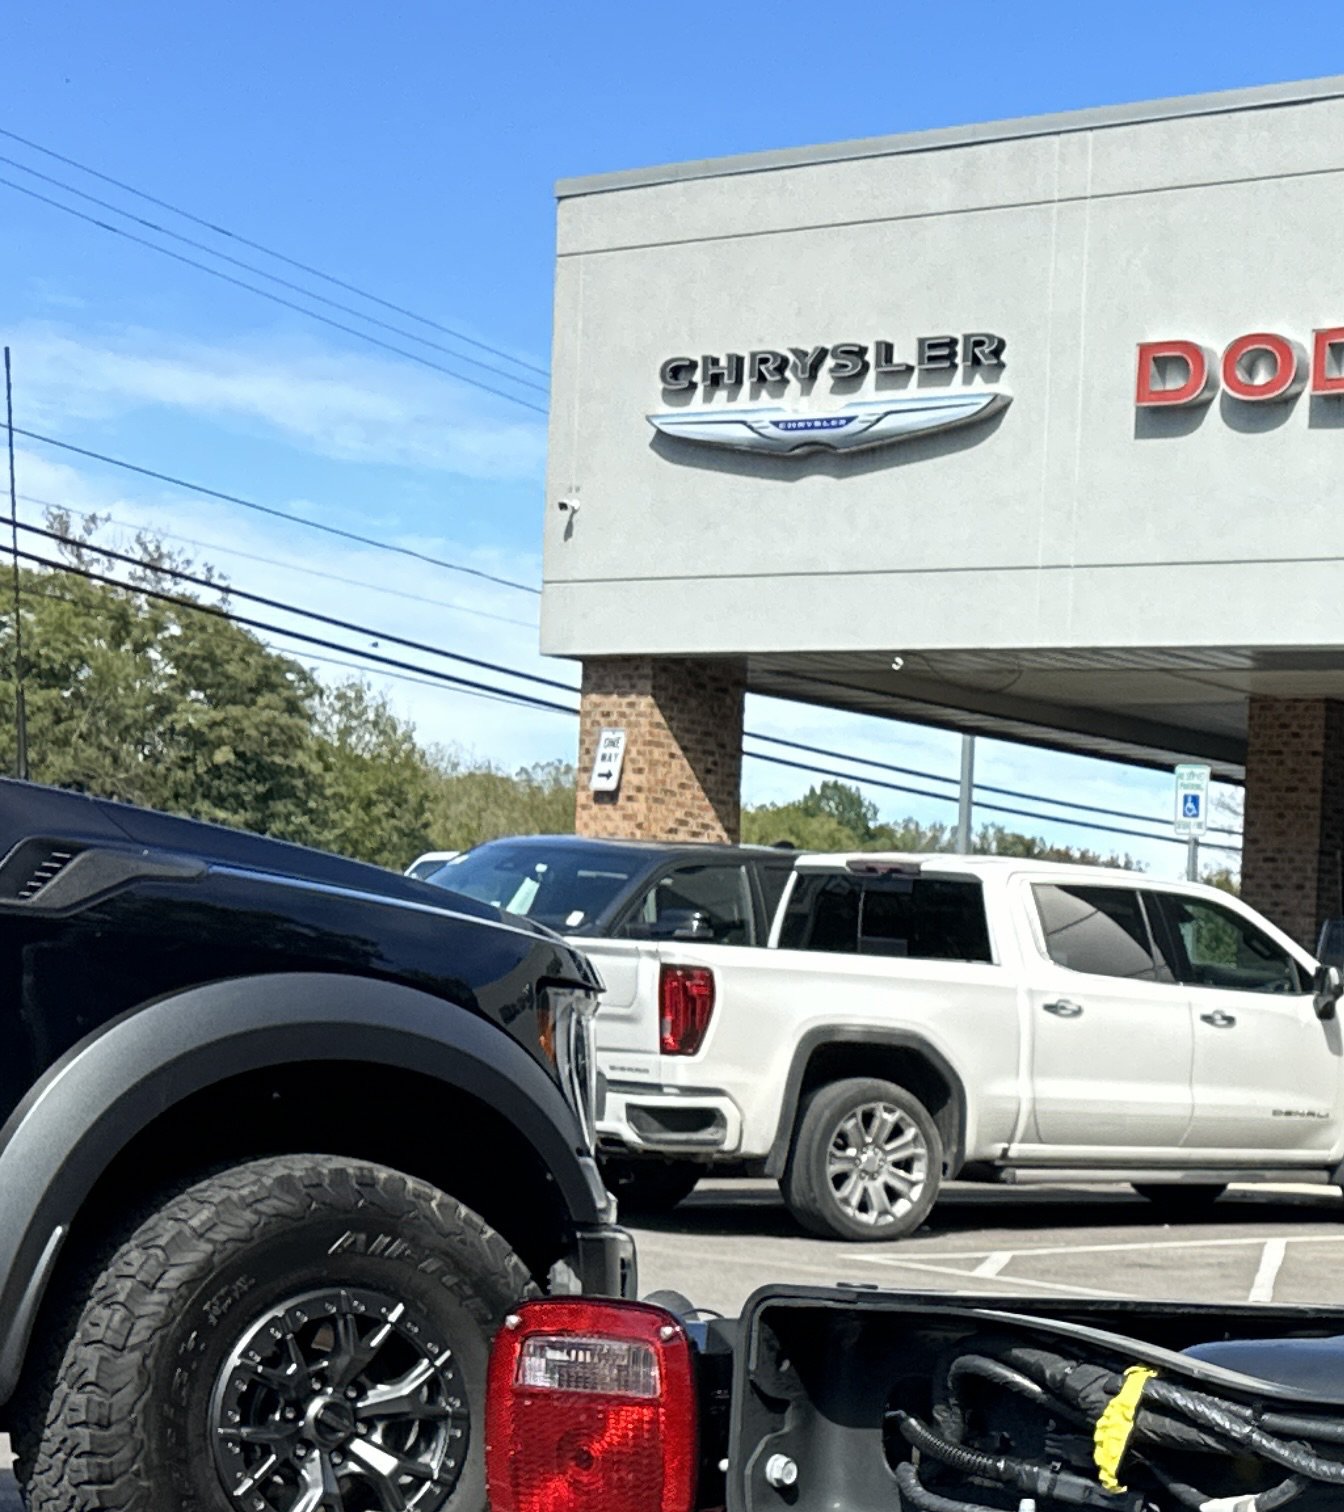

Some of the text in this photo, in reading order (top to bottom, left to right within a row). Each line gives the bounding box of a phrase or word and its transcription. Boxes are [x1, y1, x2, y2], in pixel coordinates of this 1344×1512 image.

[659, 333, 1006, 389] CHRYSLER
[778, 419, 847, 430] CHRYSLER
[603, 736, 622, 749] ONE
[600, 752, 619, 762] WAY
